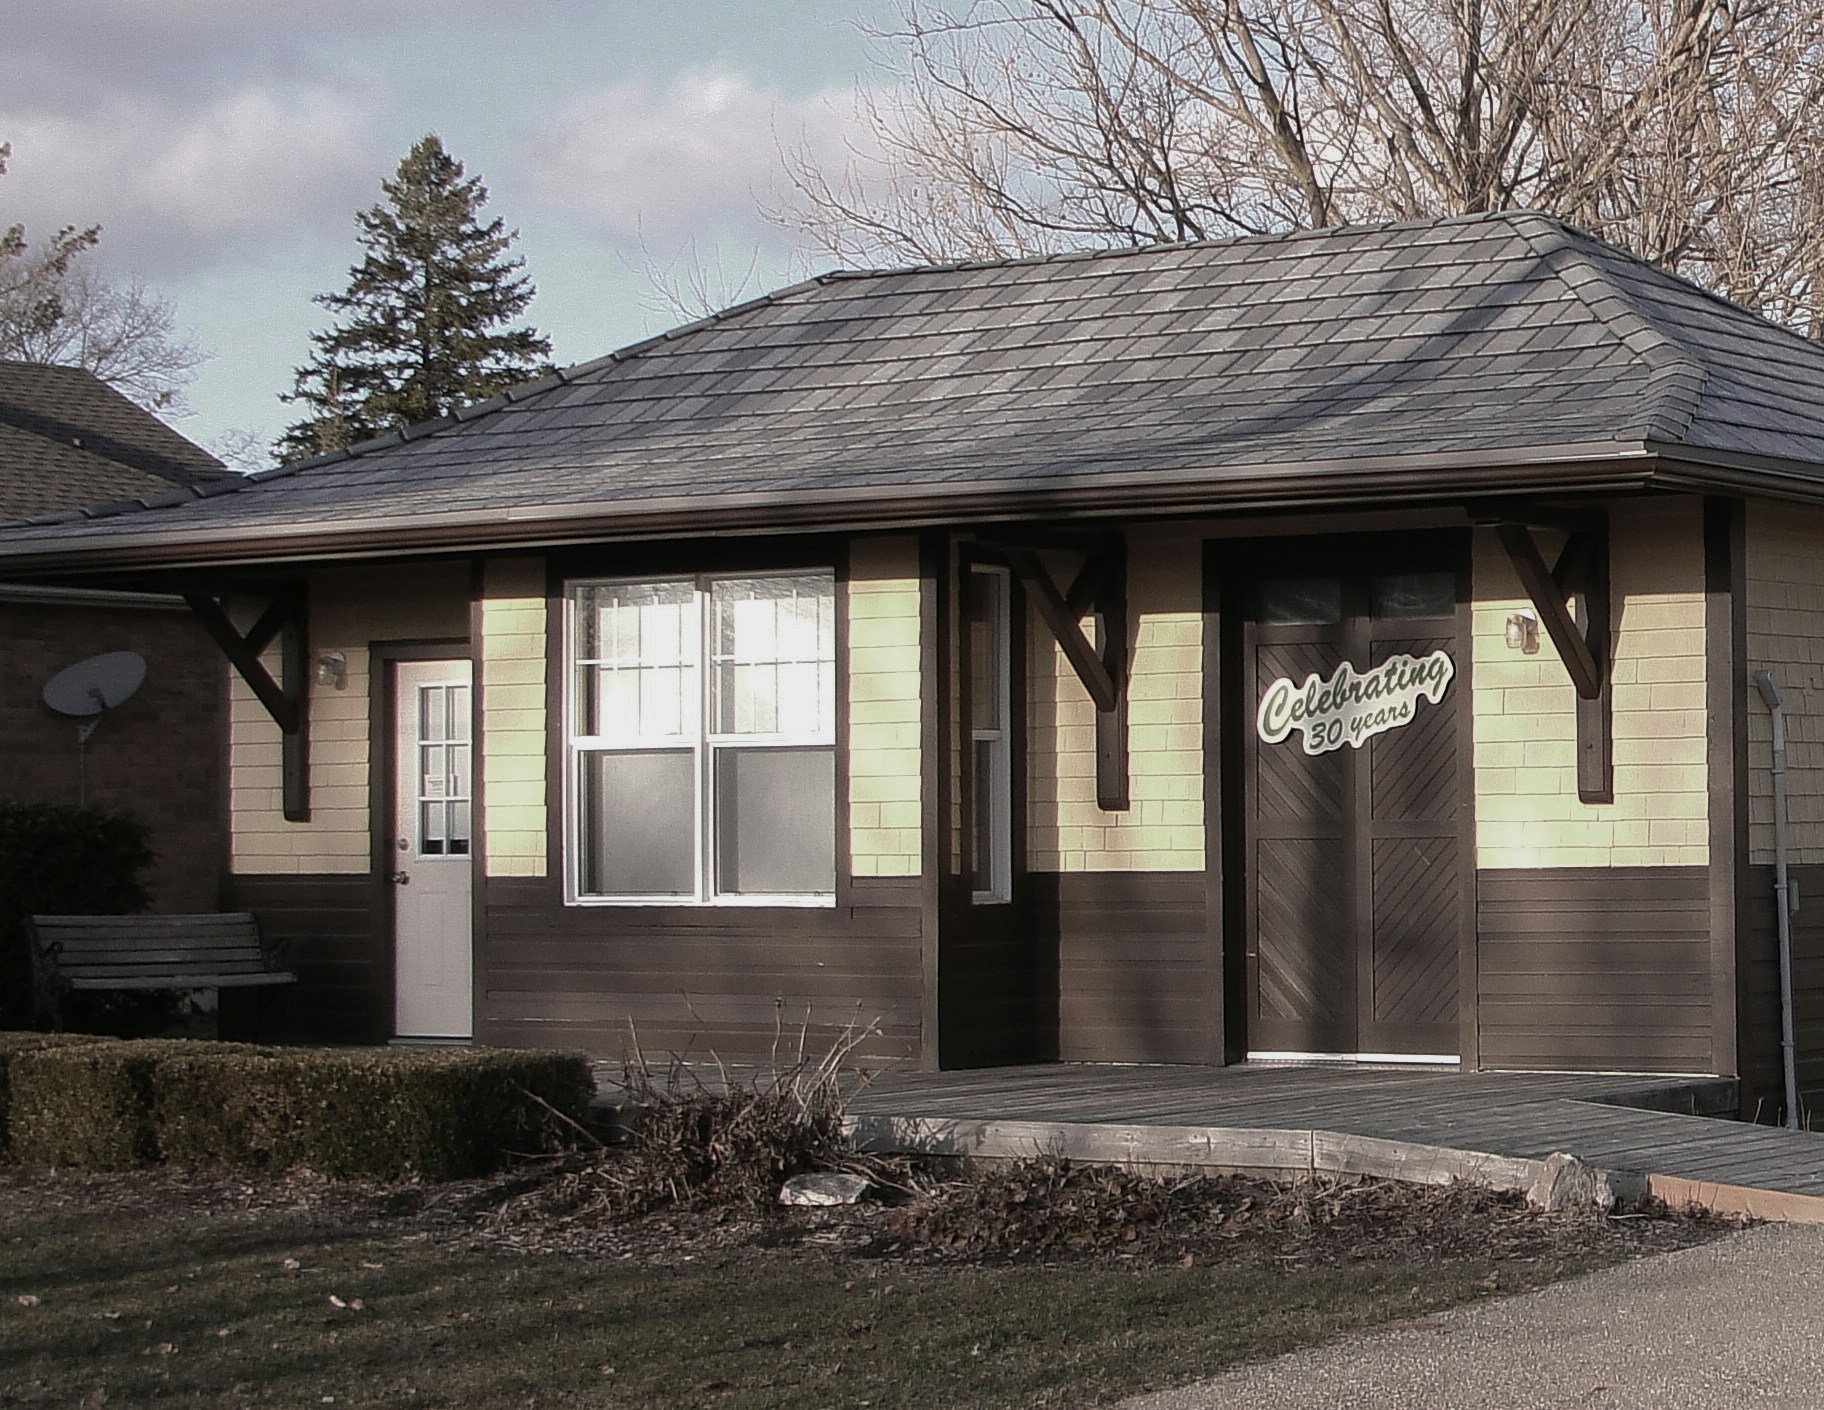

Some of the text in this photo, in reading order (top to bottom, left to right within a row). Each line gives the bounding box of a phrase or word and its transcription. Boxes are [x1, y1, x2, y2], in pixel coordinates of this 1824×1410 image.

[1263, 656, 1449, 737] Celebrating
[1309, 701, 1411, 750] 30 years
